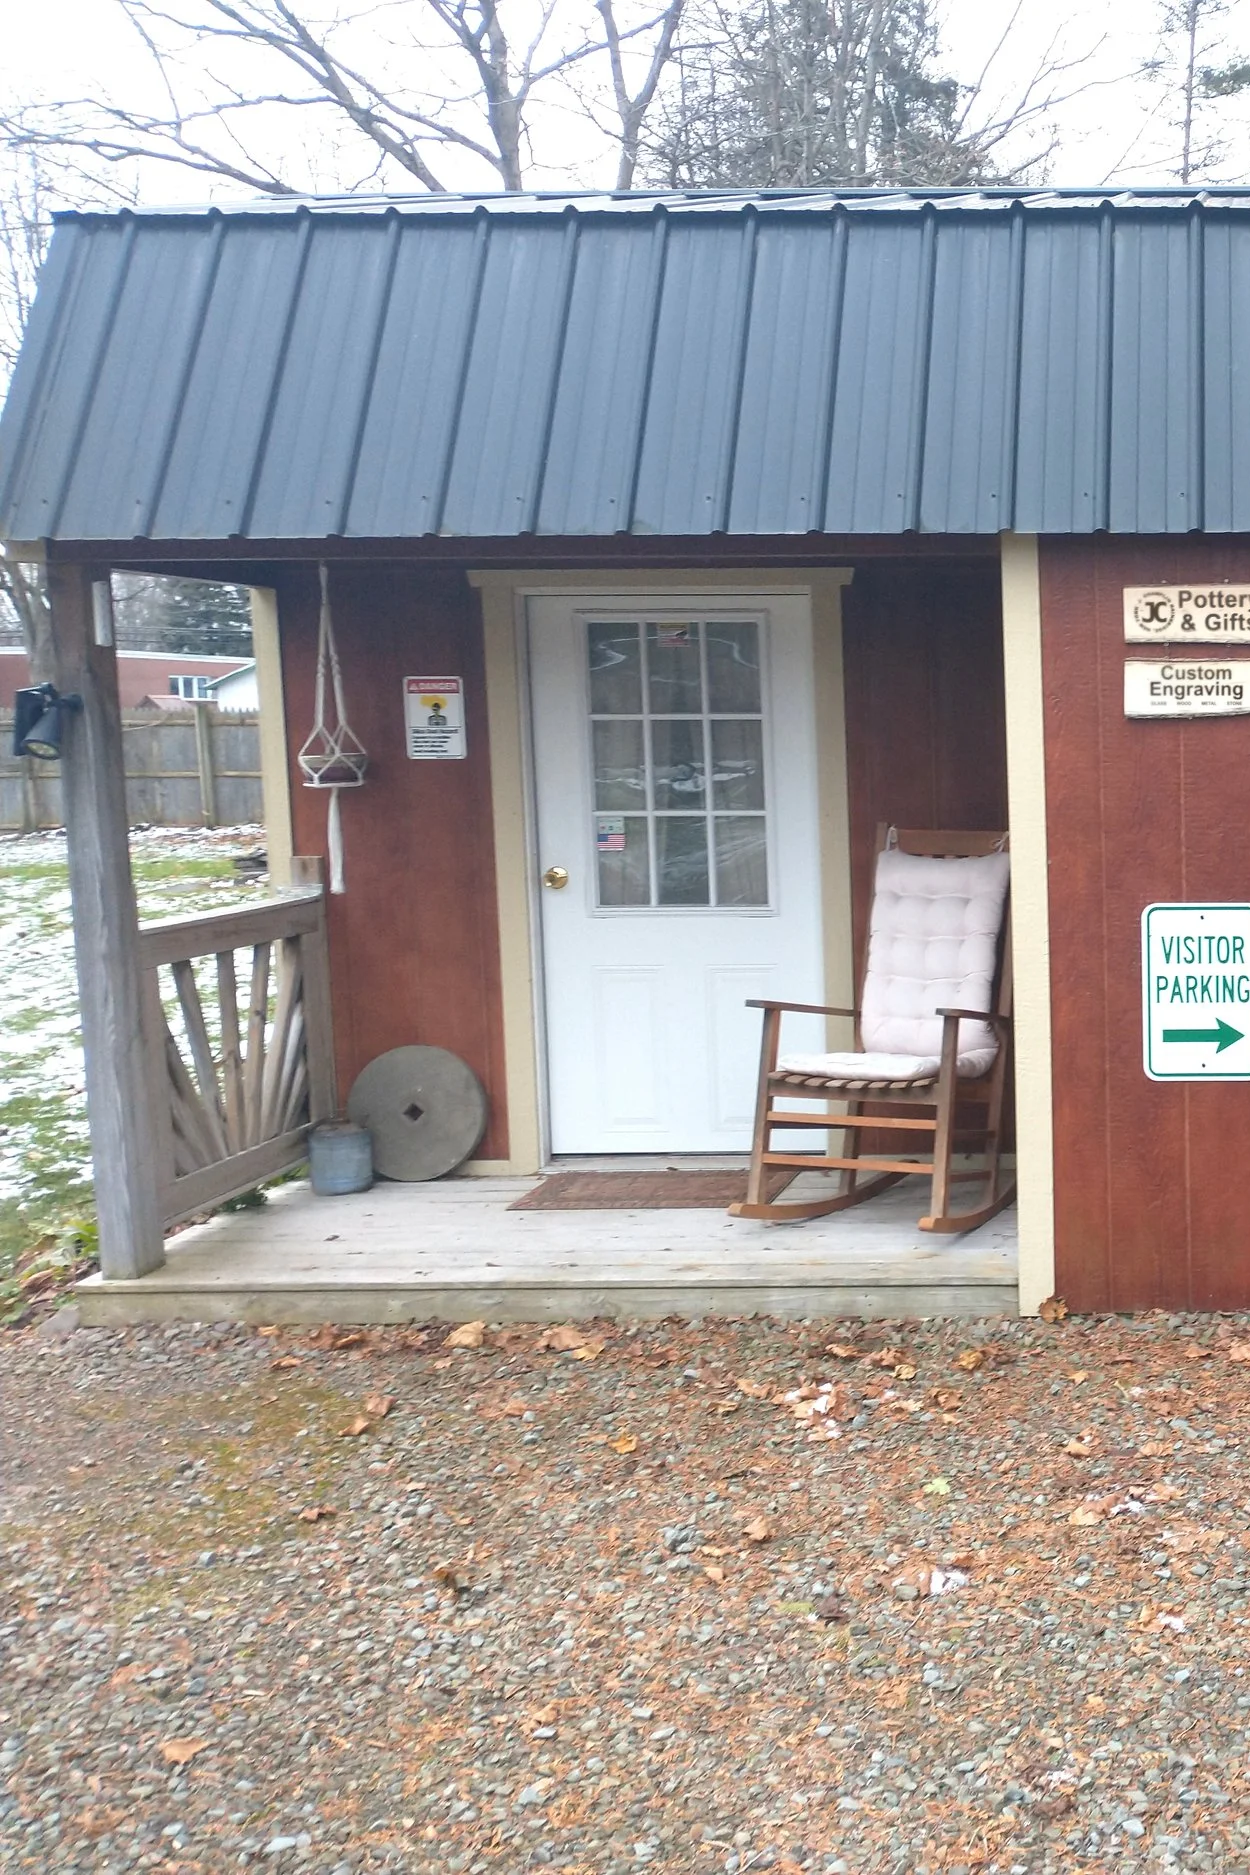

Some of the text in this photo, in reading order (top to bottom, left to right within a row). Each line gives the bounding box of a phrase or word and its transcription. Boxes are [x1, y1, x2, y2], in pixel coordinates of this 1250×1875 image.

[1141, 601, 1168, 623] JC
[1181, 614, 1196, 632] &
[1161, 665, 1232, 681] Custom
[1150, 681, 1244, 700] Engraving
[1161, 936, 1245, 964] VISITOR
[1156, 975, 1250, 1003] PARKING
